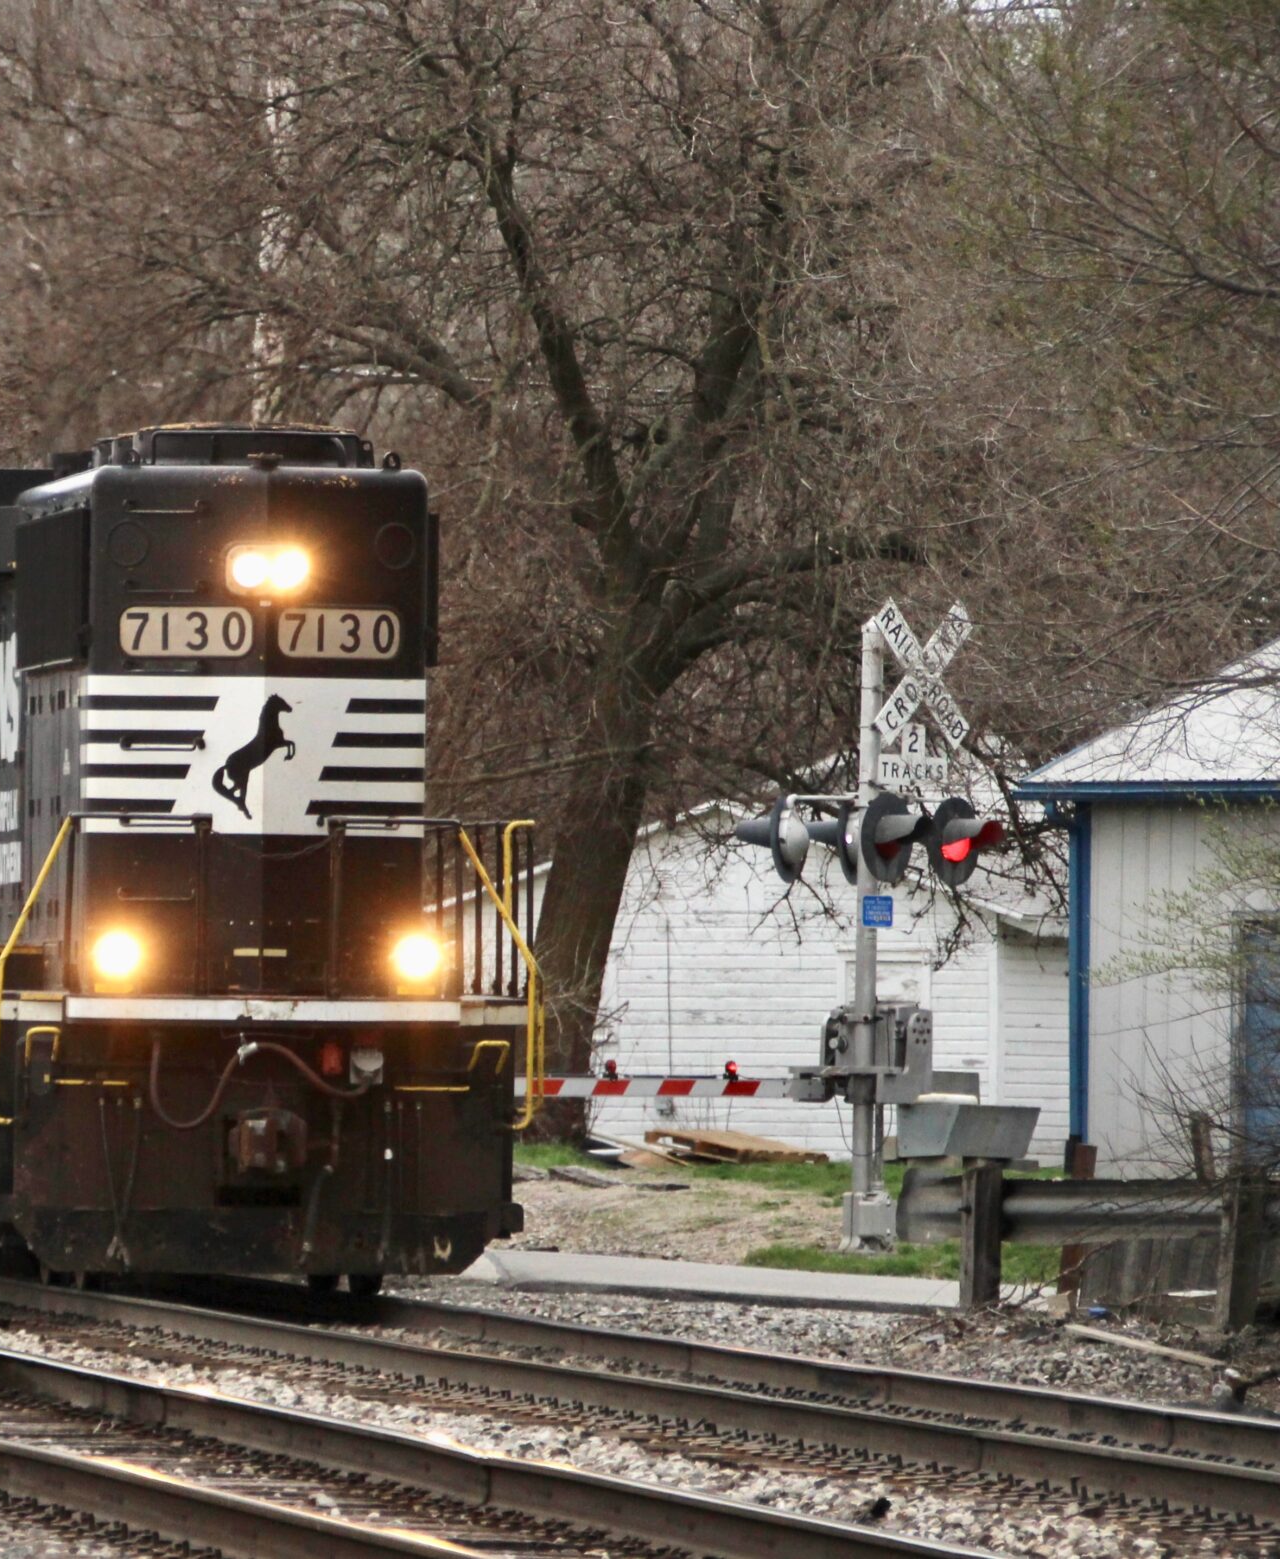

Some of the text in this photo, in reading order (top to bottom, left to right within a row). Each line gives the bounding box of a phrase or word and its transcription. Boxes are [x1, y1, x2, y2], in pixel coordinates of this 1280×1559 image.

[125, 611, 246, 651] 7130
[284, 613, 396, 654] 7130
[880, 606, 965, 741] RAIL ROAD
[907, 731, 919, 753] 2
[881, 761, 944, 781] TRACKS
